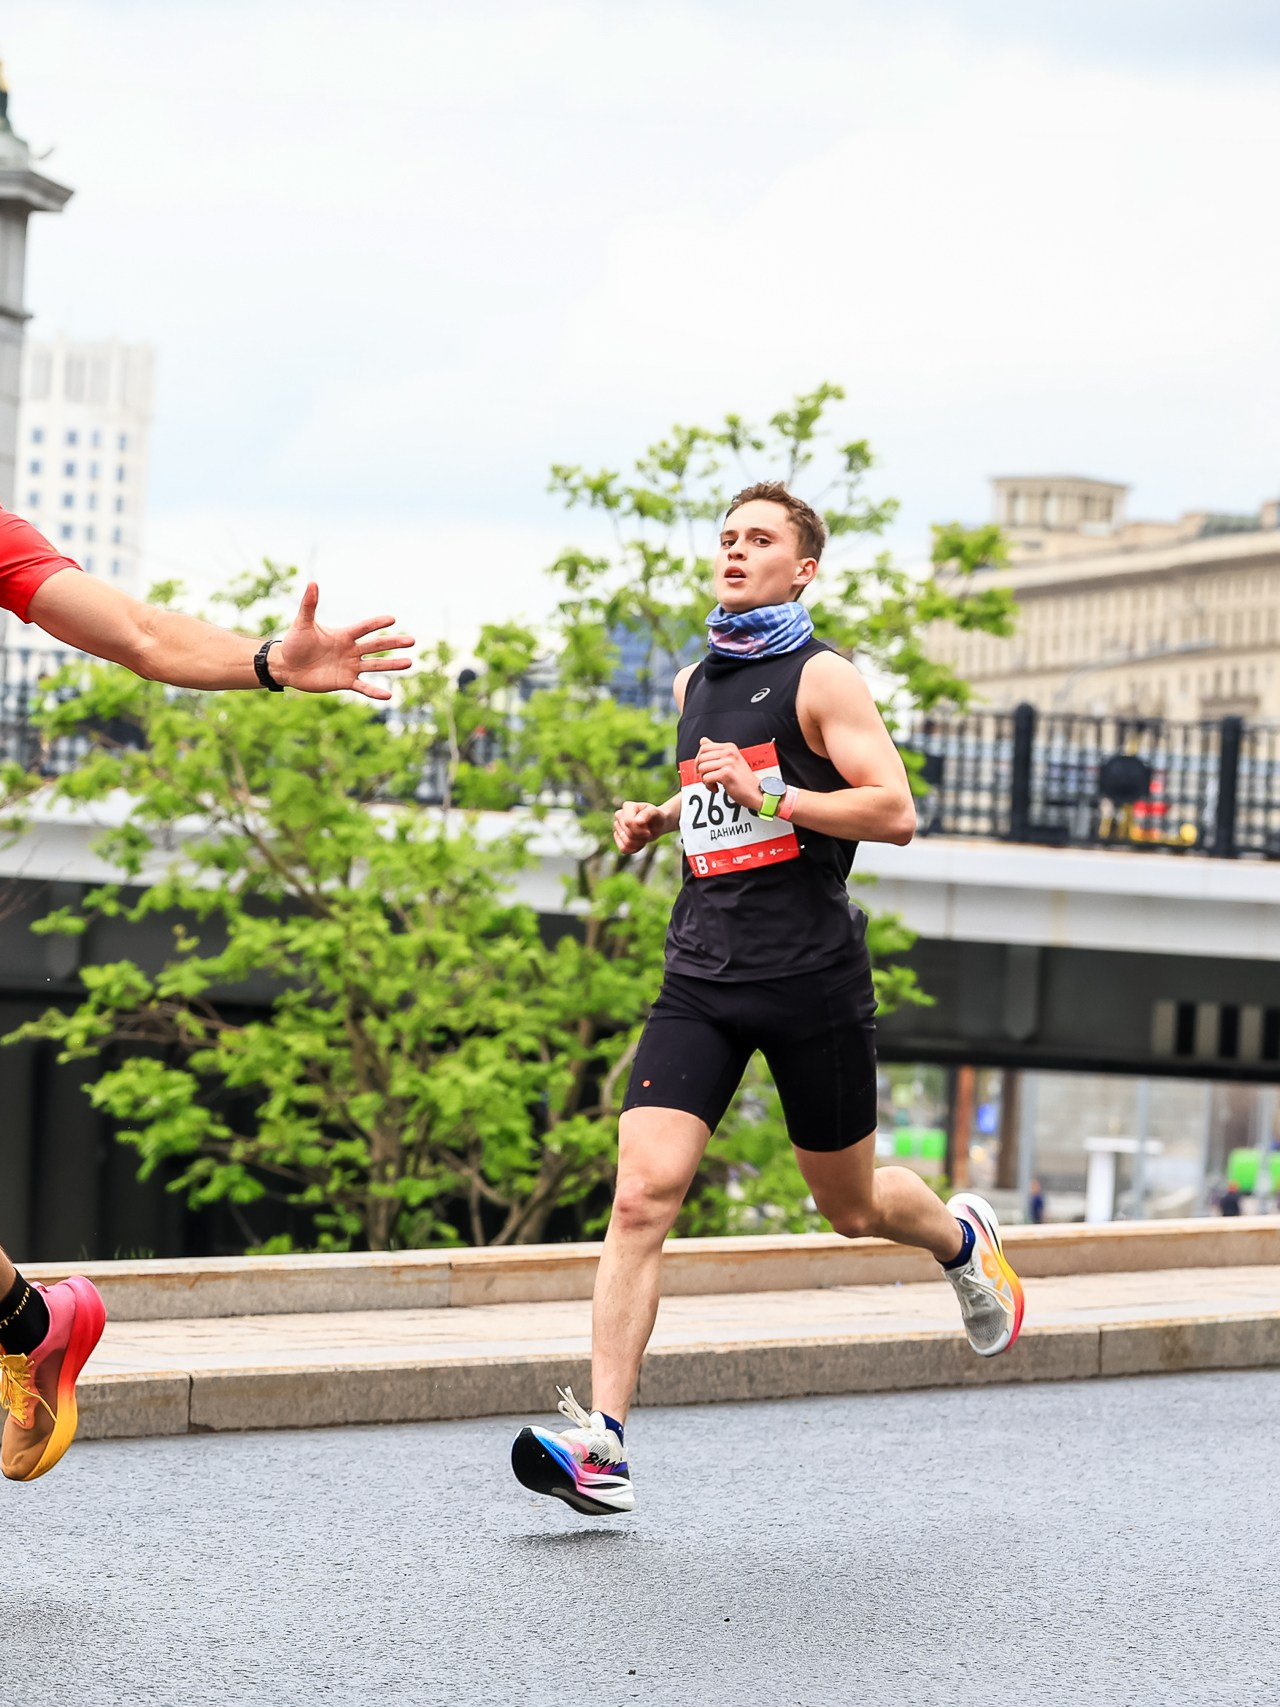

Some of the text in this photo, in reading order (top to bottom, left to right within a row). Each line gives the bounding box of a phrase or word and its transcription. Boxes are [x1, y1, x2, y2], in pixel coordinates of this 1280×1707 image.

[689, 791, 760, 830] 269
[710, 822, 753, 841] ДАНИИЛ
[695, 855, 709, 875] B
